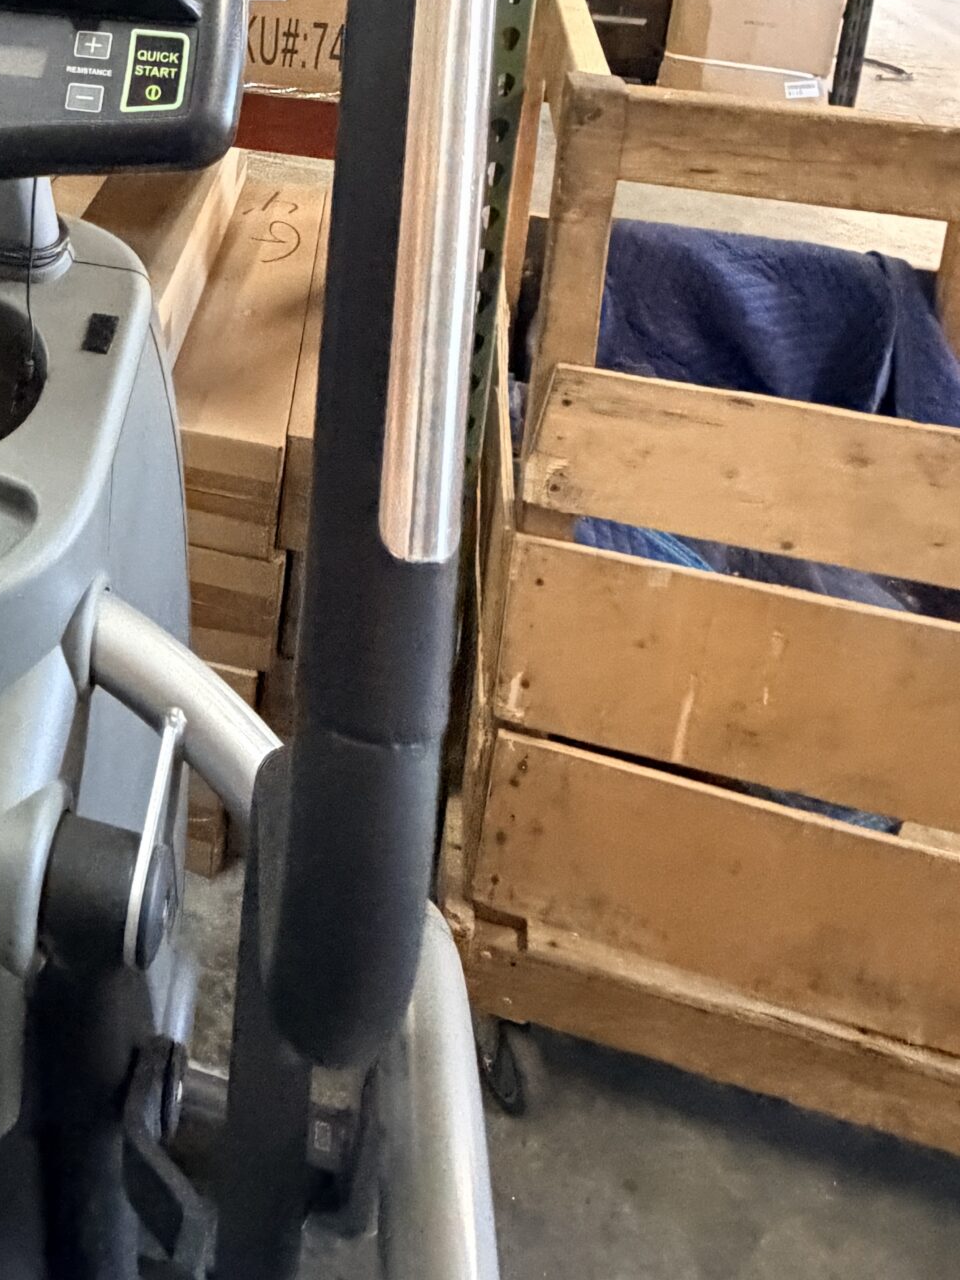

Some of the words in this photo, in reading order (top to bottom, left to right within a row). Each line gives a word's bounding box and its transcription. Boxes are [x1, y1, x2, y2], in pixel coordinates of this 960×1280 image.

[137, 49, 180, 64] QUICK
[66, 65, 113, 78] RESISTANCE
[134, 65, 178, 79] START
